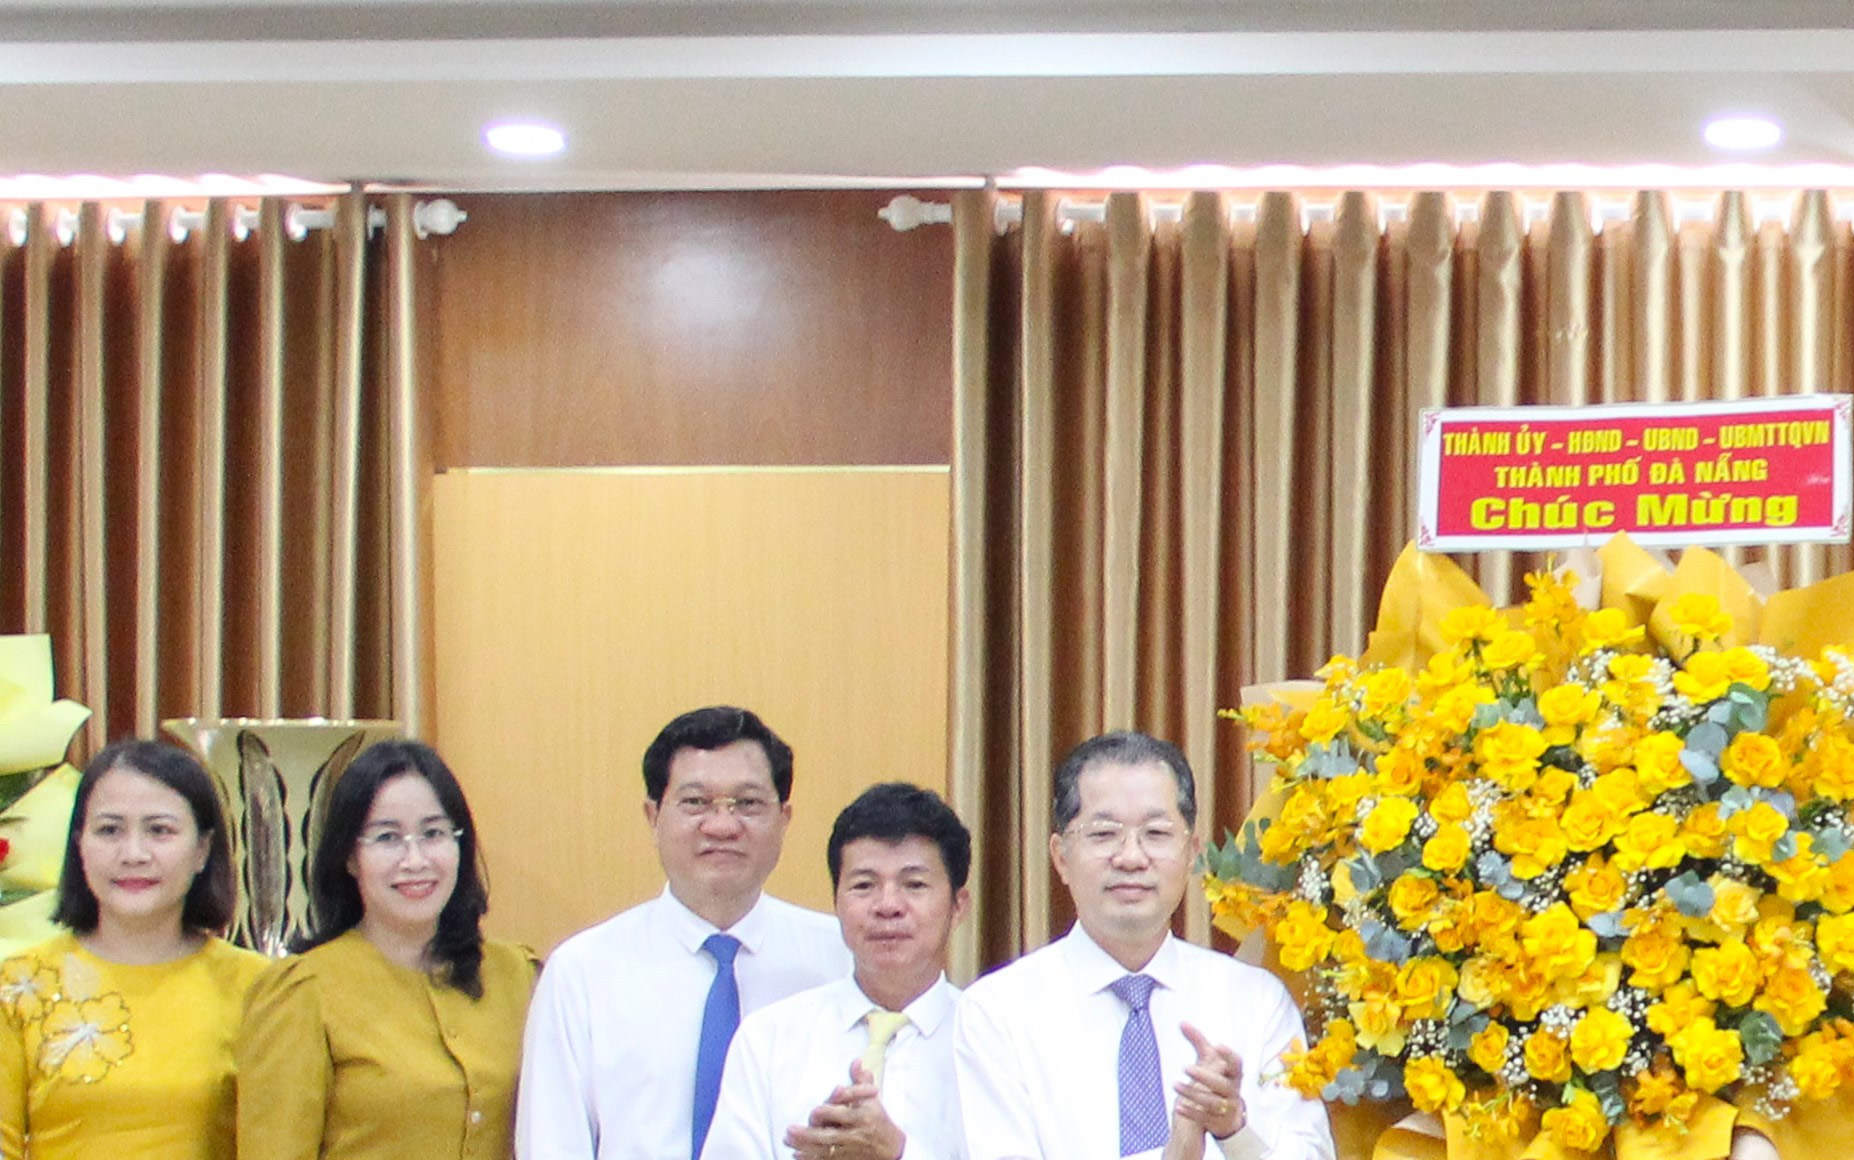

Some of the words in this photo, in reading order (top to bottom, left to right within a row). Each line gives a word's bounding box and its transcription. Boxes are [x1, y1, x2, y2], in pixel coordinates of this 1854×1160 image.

[1443, 426, 1511, 456] THÀNH
[1516, 424, 1547, 455] ỦY
[1568, 429, 1623, 454] HĐND
[1643, 427, 1699, 451] UBND
[1719, 420, 1830, 449] UBMTTQVN
[1494, 461, 1581, 488] THÀNH
[1587, 456, 1642, 487] PHỐ
[1649, 457, 1686, 485] ĐÀ
[1694, 452, 1769, 484] NẴNG
[1470, 494, 1616, 530] Chúc
[1636, 490, 1798, 527] Mừng
